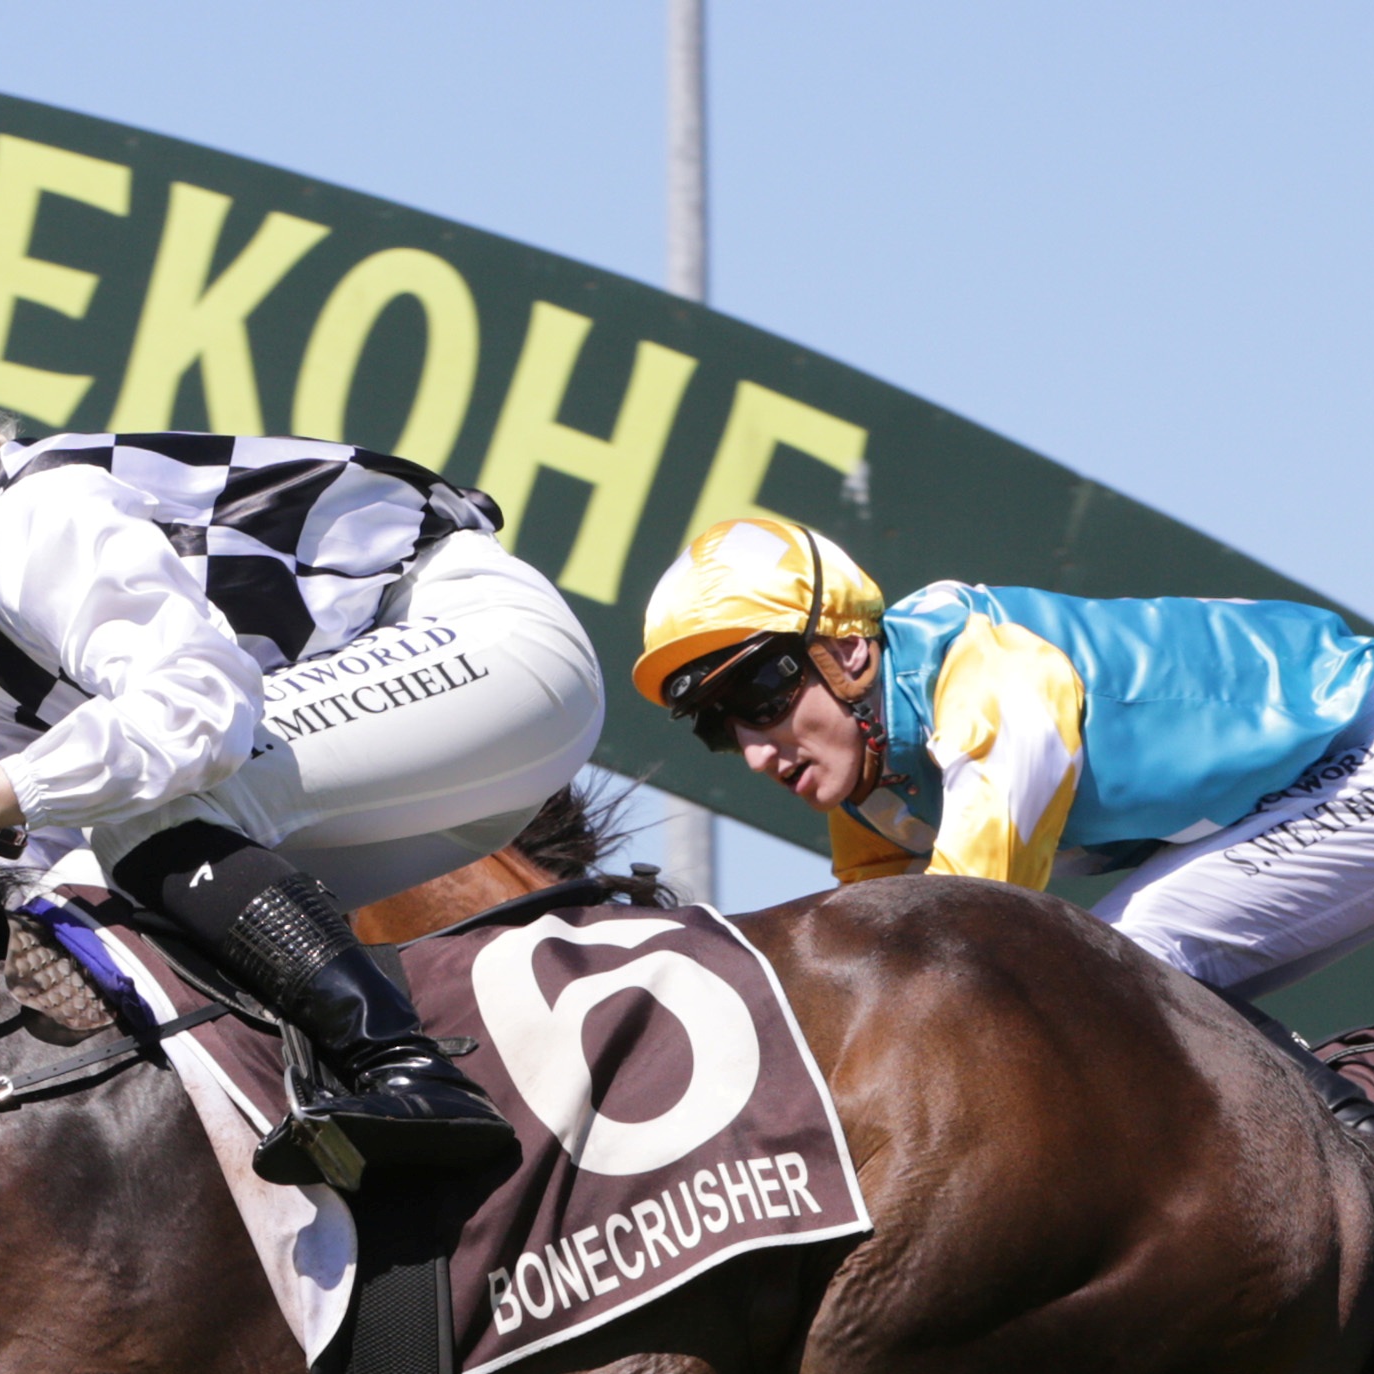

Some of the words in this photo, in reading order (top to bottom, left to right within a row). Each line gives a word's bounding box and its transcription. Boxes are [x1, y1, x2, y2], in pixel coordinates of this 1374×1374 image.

[264, 626, 457, 703] UIWORLD
[268, 651, 490, 742] MITCHELL
[471, 914, 761, 1177] 6
[487, 1151, 823, 1337] BONECRUSHER
